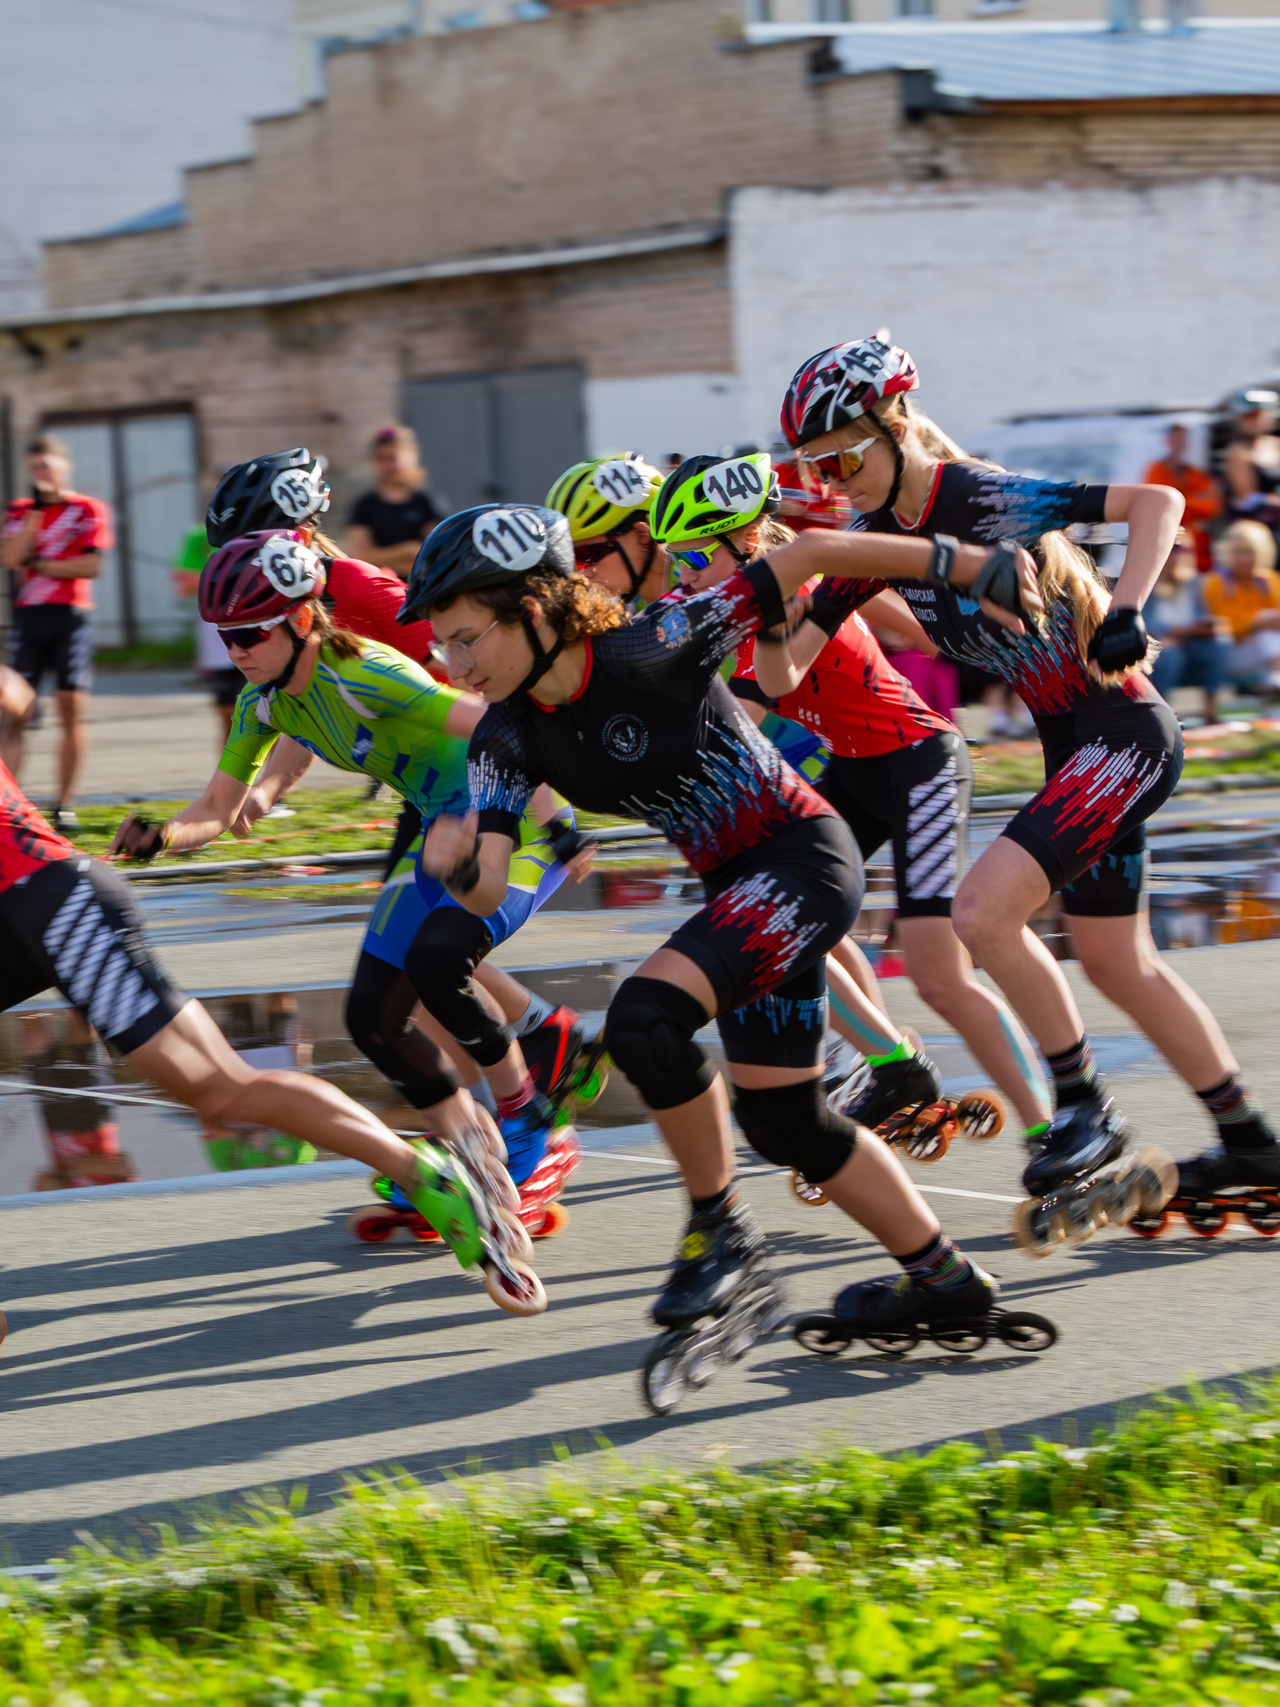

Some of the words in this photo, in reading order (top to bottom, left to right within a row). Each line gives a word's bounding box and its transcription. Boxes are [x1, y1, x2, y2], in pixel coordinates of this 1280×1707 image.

[707, 462, 763, 507] 140
[480, 511, 545, 564] 110
[699, 515, 740, 535] RUDY
